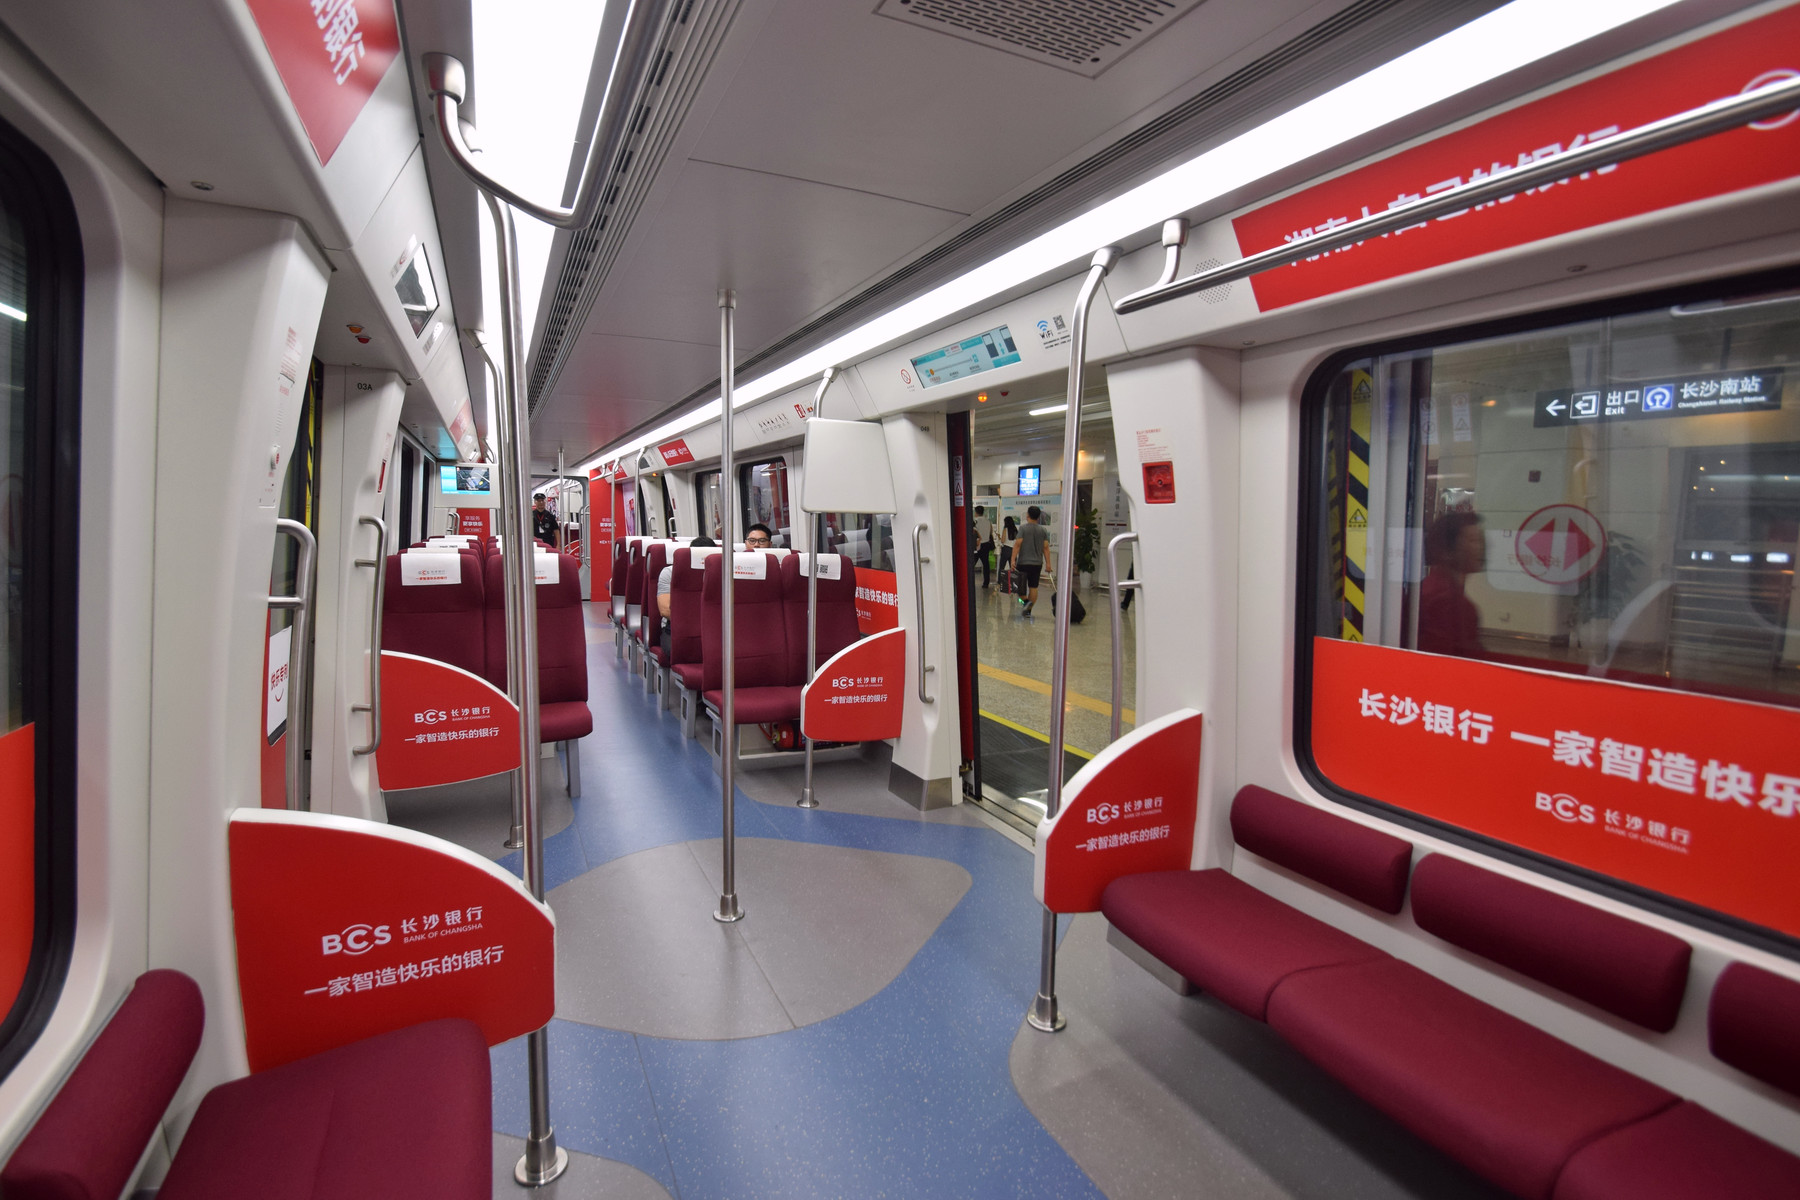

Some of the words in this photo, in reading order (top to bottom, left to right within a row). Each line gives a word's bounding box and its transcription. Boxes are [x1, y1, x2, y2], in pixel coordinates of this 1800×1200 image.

[357, 382, 373, 391] 03A
[1680, 376, 1762, 399] 长沙南站
[1607, 390, 1639, 406] 出口
[1605, 406, 1625, 415] Exit
[832, 676, 855, 689] BCS
[824, 693, 888, 704] 一家智造快乐的银行
[414, 709, 448, 725] BCS
[451, 706, 491, 717] 长沙银行
[404, 727, 500, 744] 一家智造快乐的银行
[1358, 688, 1495, 745] 长沙银行
[1510, 730, 1800, 818] 一家智造快乐
[1086, 802, 1120, 825] BCS
[1123, 797, 1164, 813] 长沙银行
[1535, 792, 1596, 824] BCS
[1603, 808, 1691, 845] 长沙银行
[1075, 825, 1170, 852] 一家智造快乐的银行
[1604, 825, 1627, 837] BANK
[1628, 831, 1640, 840] OF
[1640, 834, 1689, 855] CHANGSHA
[401, 905, 483, 935] 长沙银行
[321, 923, 393, 956] BCS
[403, 934, 426, 944] BANK
[427, 931, 438, 939] OF
[440, 922, 483, 937] CHANGSHA
[304, 944, 505, 998] 一家智造快乐的银行
